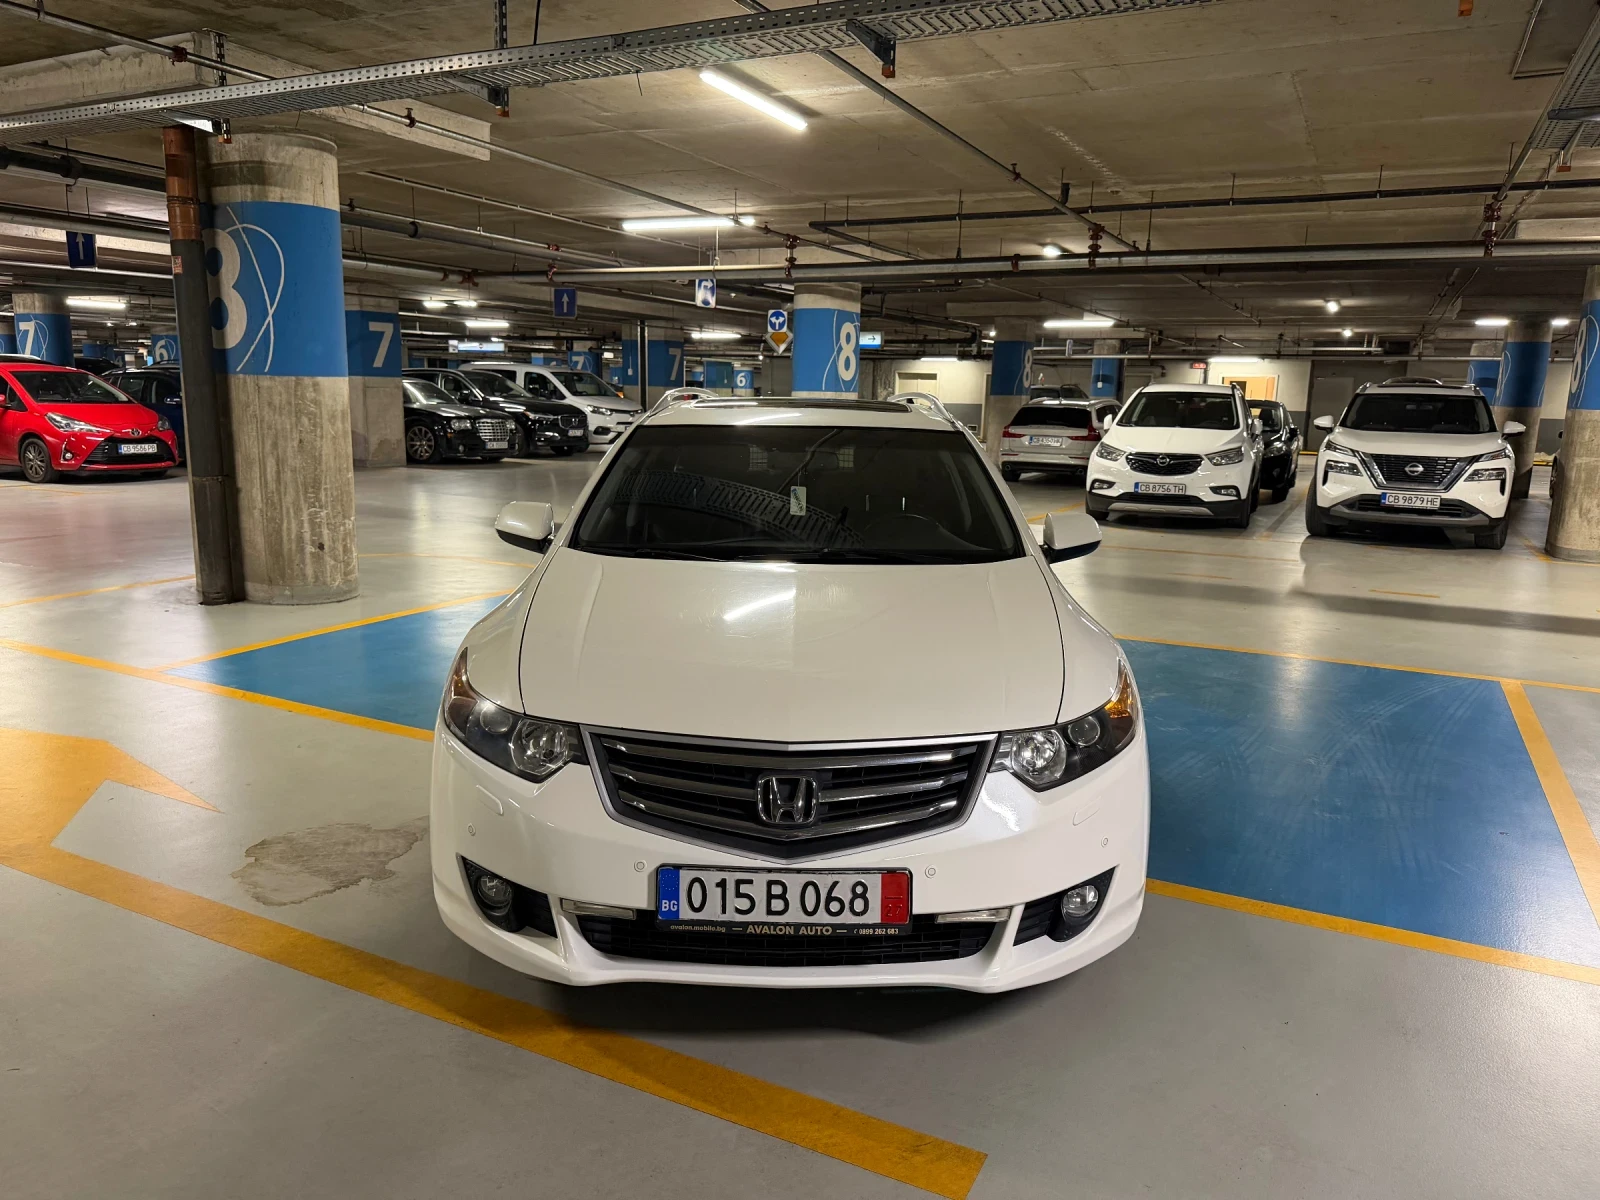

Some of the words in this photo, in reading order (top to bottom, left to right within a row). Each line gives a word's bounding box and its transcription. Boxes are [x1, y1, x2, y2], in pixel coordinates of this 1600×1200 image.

[18, 320, 36, 356] 7
[155, 340, 169, 362] 6
[368, 321, 394, 368] 7
[838, 322, 857, 381] 8
[668, 347, 682, 381] 7
[736, 372, 747, 387] 6
[1022, 349, 1033, 388] 8
[661, 899, 678, 911] BG
[746, 924, 794, 935] AVALON
[799, 926, 833, 935] AUTO
